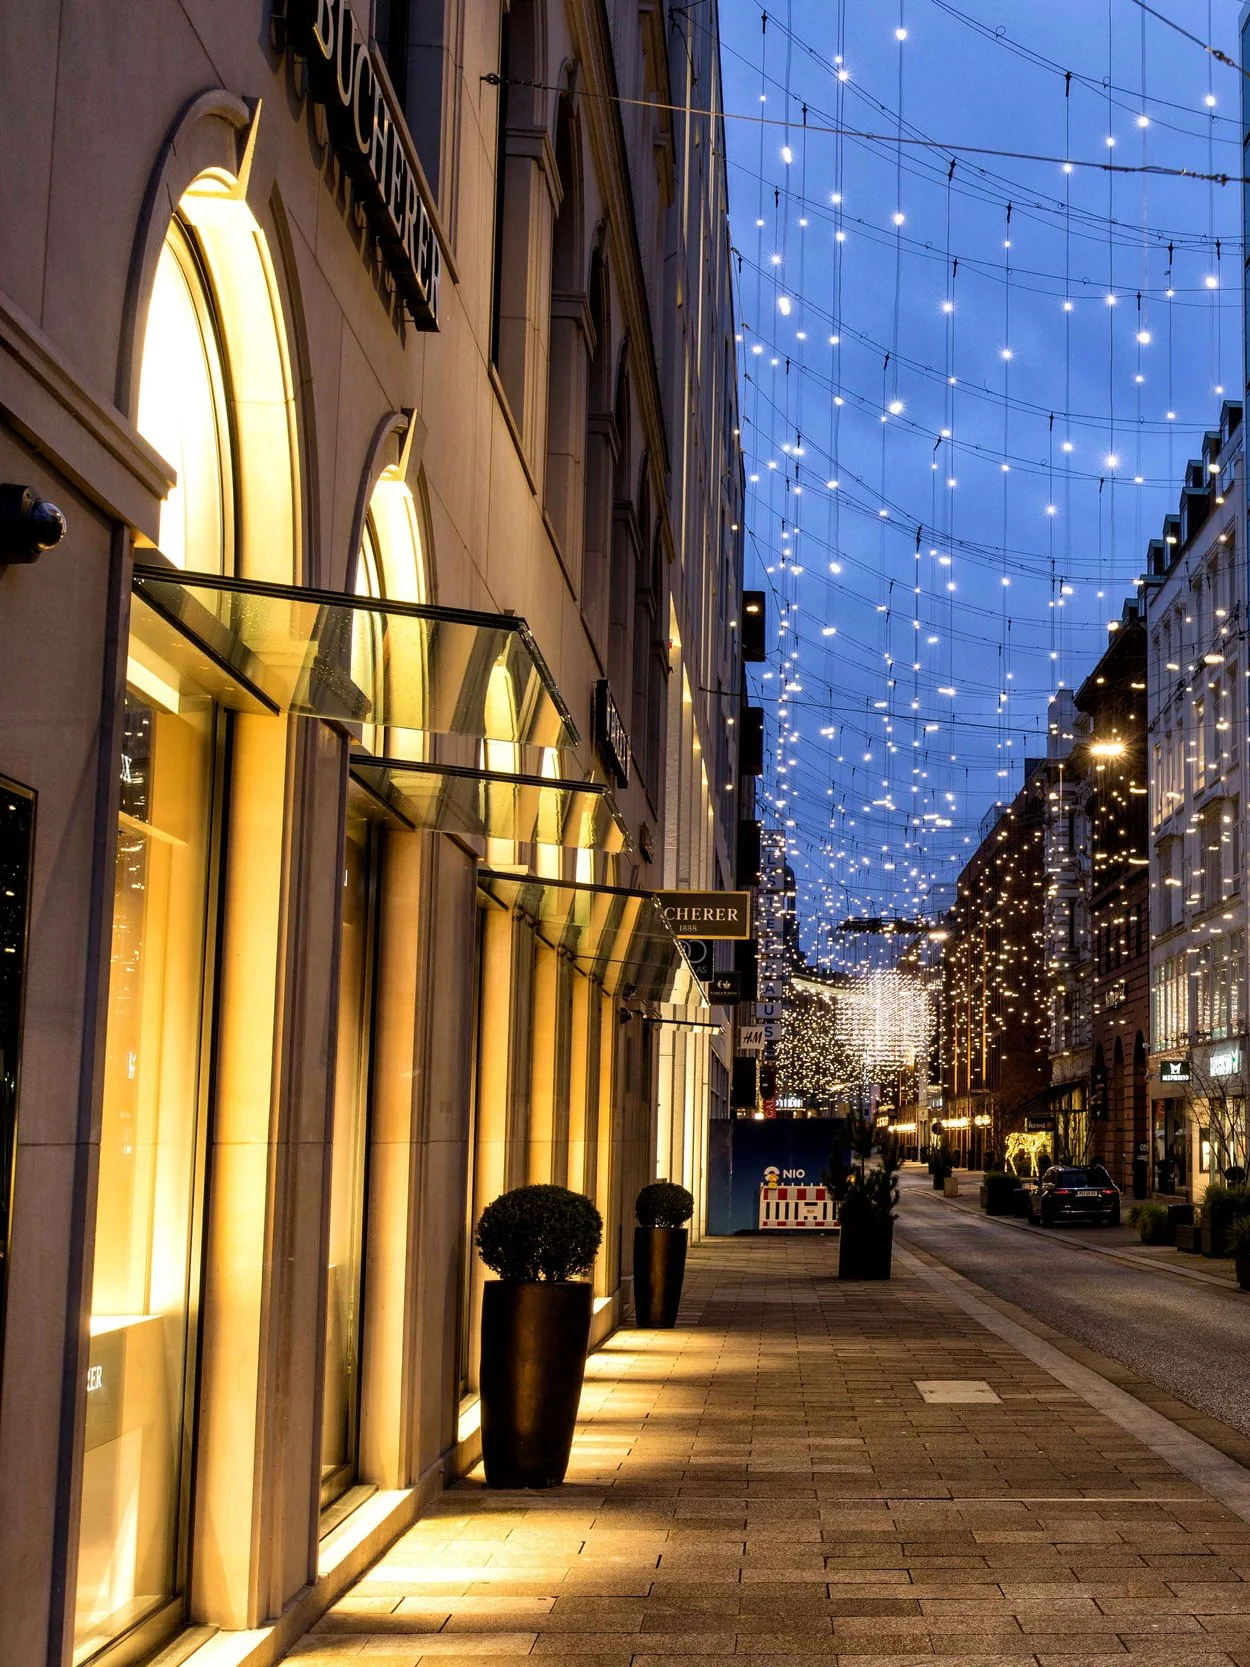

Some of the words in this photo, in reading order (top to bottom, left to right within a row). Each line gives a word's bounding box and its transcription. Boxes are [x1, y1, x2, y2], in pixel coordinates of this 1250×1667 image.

[679, 924, 697, 932] 1888
[743, 1031, 762, 1044] H&M
[783, 1169, 805, 1179] NIO
